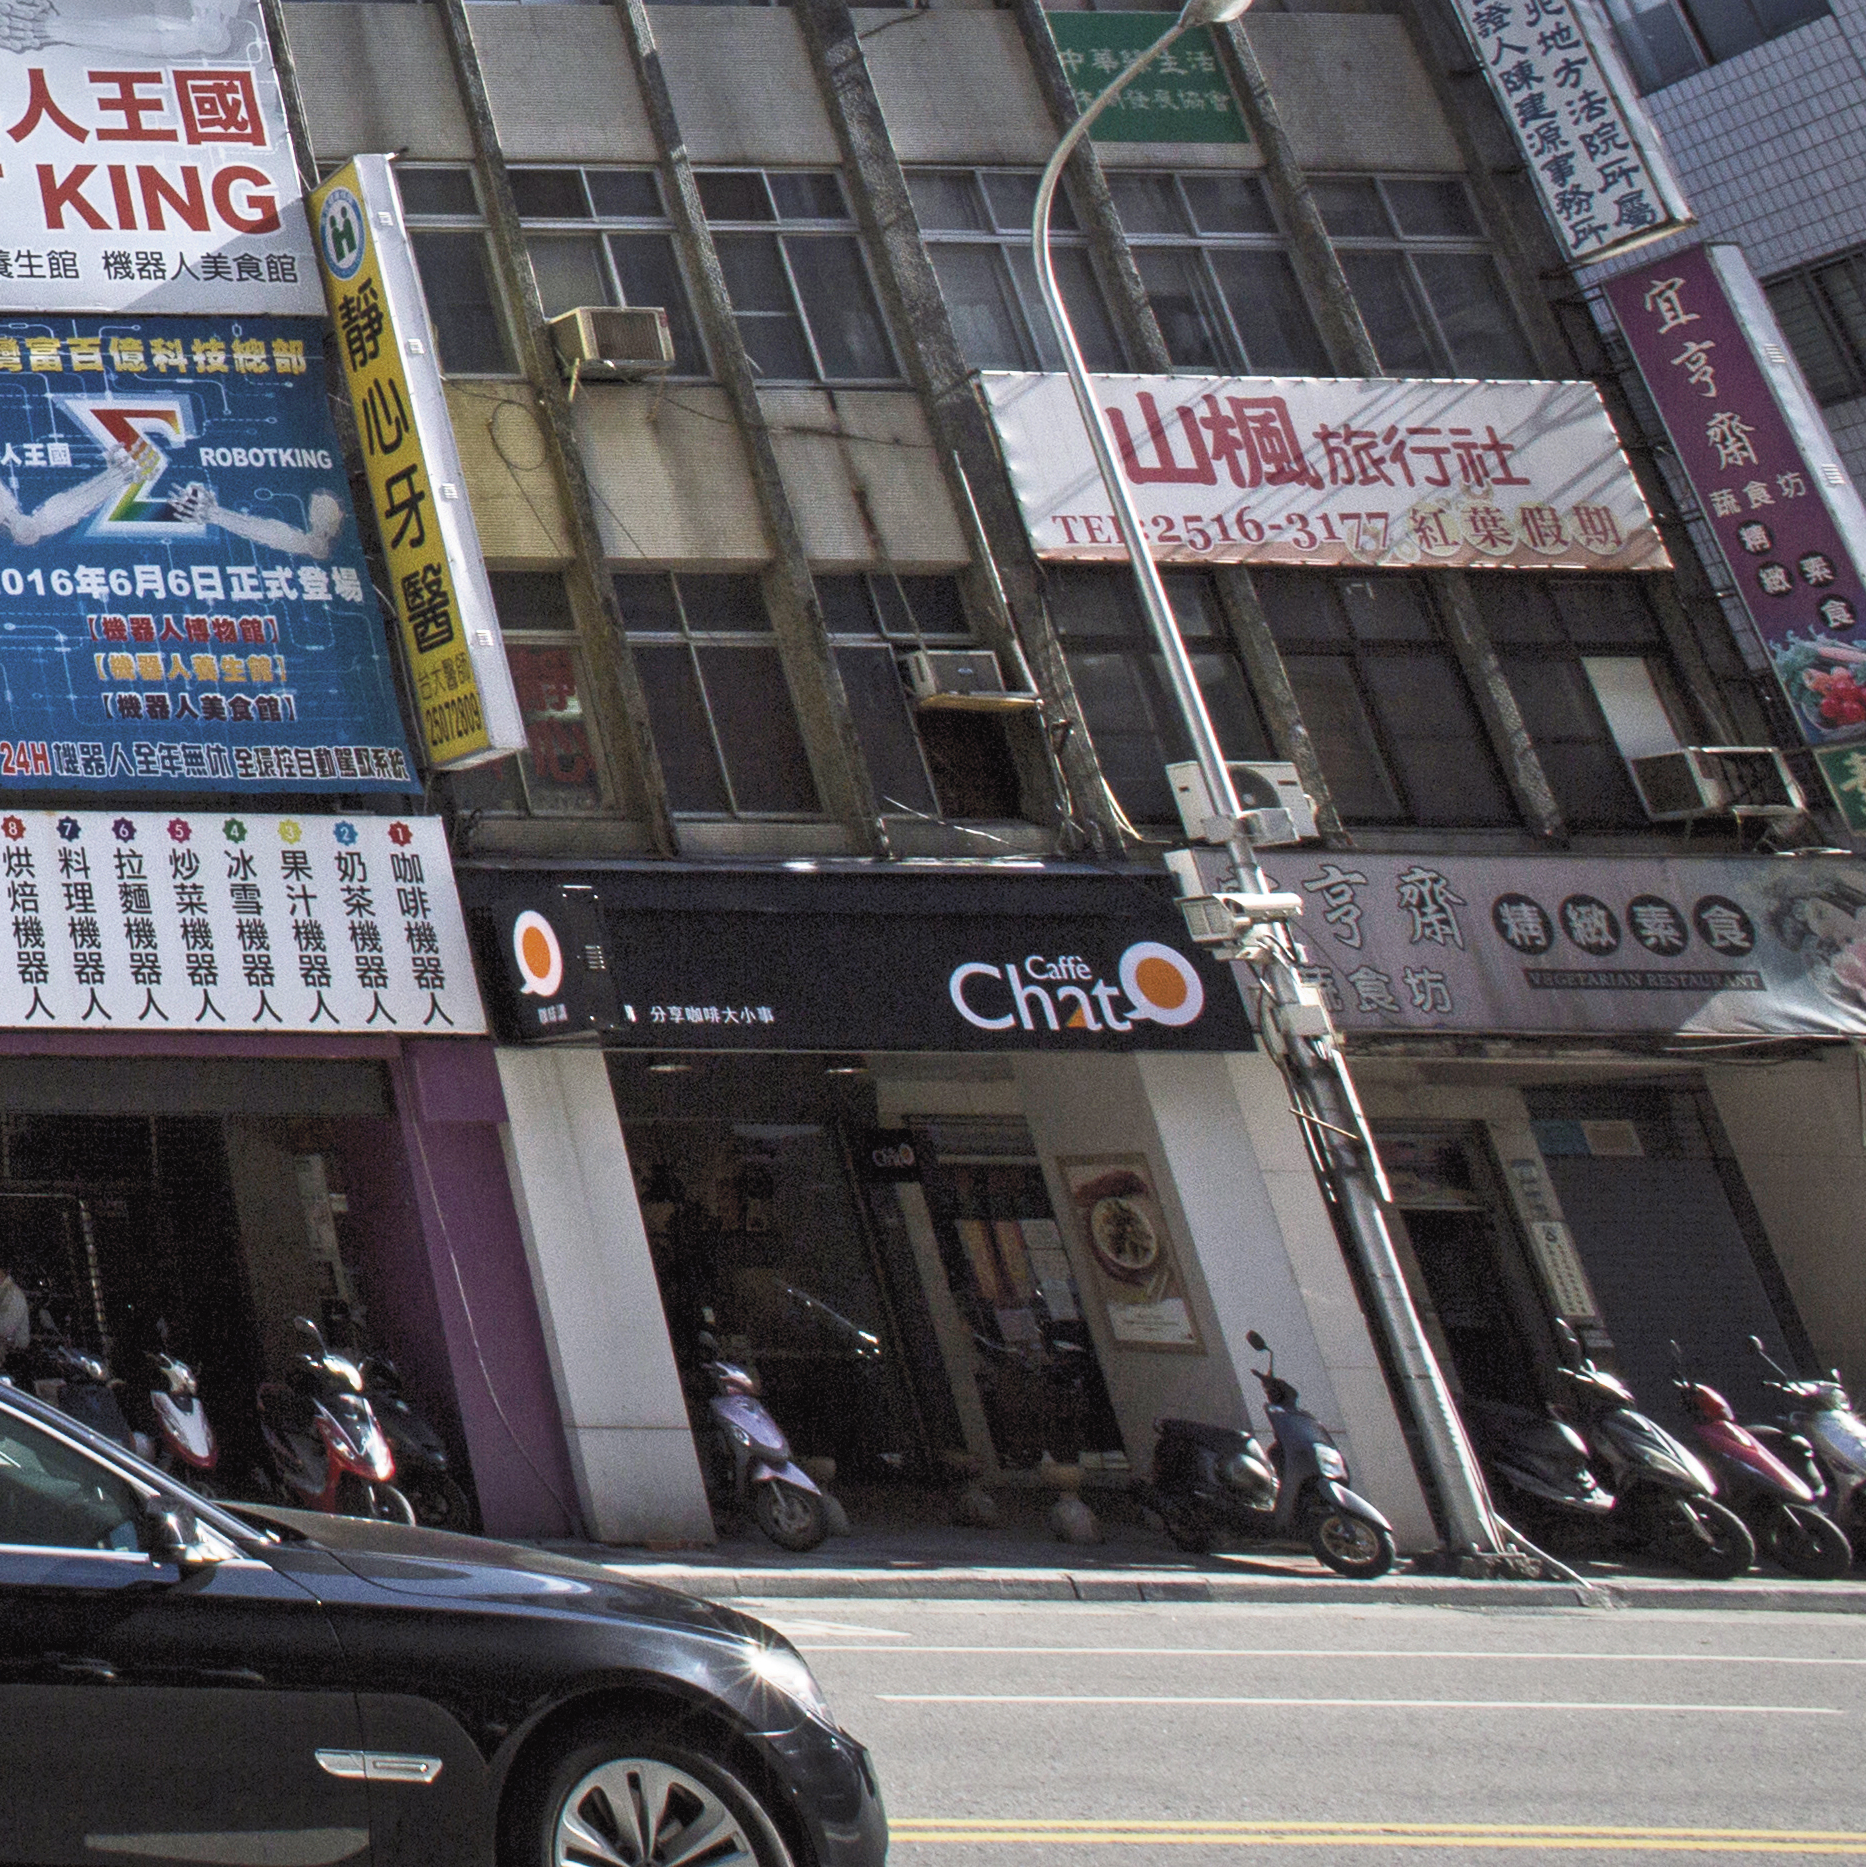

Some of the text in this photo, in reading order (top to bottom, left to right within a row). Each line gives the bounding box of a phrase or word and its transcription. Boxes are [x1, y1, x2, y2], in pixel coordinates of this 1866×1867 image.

[35, 163, 282, 235] KING
[102, 250, 299, 285] 機器人美食館
[198, 446, 333, 470] ROBOTKING
[338, 277, 454, 656] 靜心牙醫
[1105, 391, 1531, 491] 山楓旅行社
[1409, 504, 1624, 550] 紅葉假期
[1709, 472, 1807, 519] 蔬食坊
[1800, 553, 1855, 628] 素食
[2, 846, 56, 1021] 烘焙機器人
[58, 847, 113, 1022] 料理機器人
[113, 848, 170, 1022] 拉麵機器人
[168, 848, 227, 1023] 炒菜機器人
[223, 849, 284, 1023] 冰雪機器人
[279, 850, 340, 1025] 果汁機器人
[333, 851, 398, 1025] 奶茶機器人
[390, 852, 455, 1027] 咖啡機器人
[1498, 901, 1753, 951] 精緻素食
[949, 962, 1131, 1033] Chat
[1024, 954, 1093, 982] Caffè
[1529, 971, 1760, 990] VEGETARIAN RESTAURANT
[649, 1004, 775, 1025] 分享咖啡大小事
